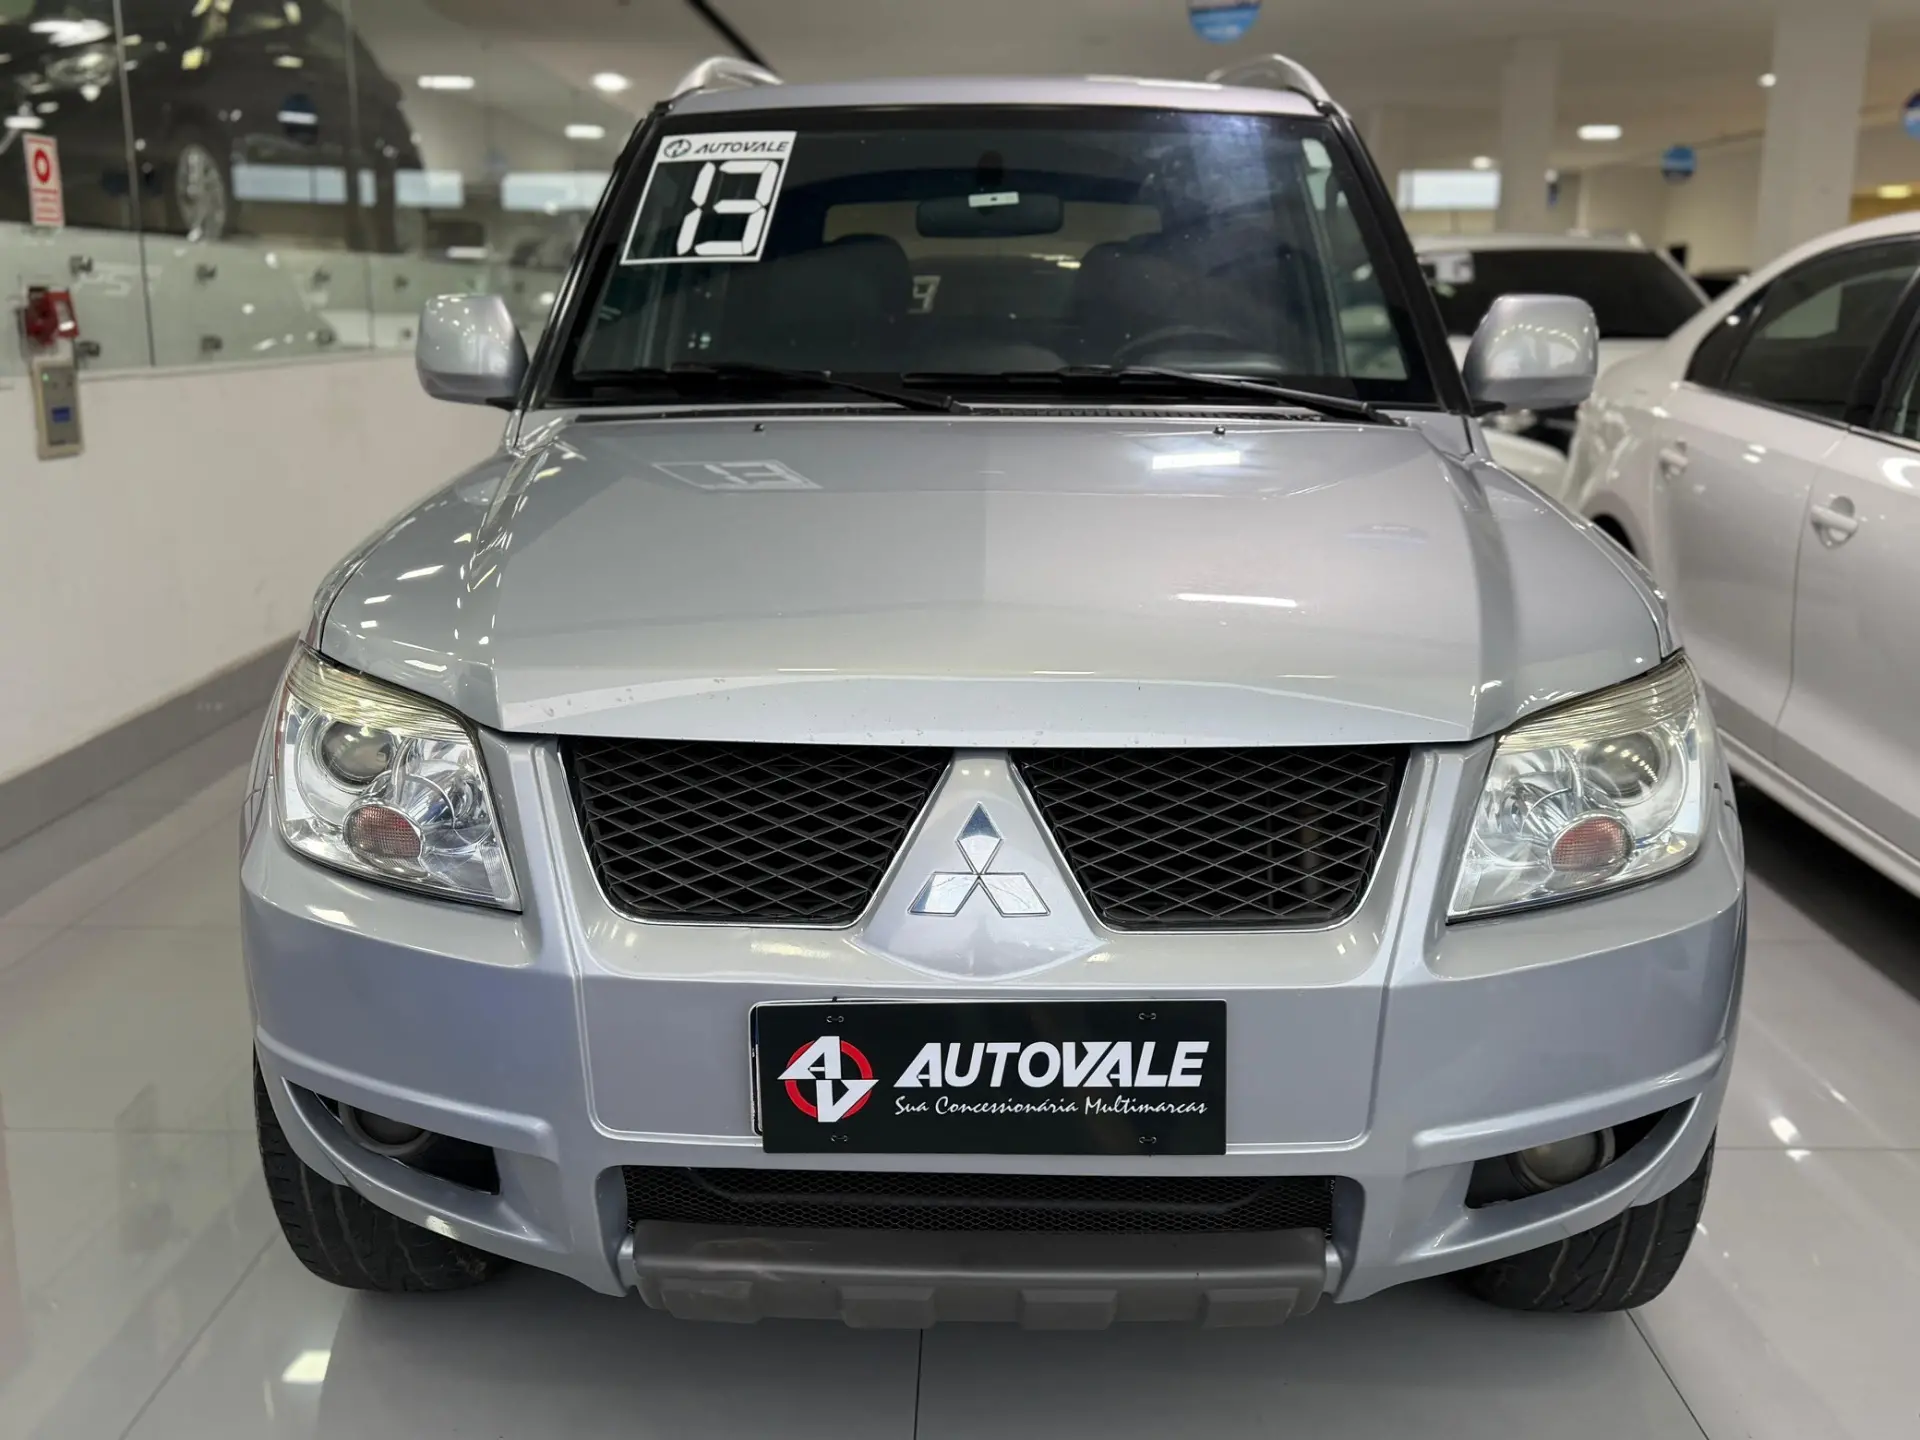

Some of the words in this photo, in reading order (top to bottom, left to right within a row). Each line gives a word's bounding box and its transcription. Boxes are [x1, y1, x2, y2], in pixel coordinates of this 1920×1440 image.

[694, 141, 789, 154] AUTOVALE
[676, 160, 780, 256] 13
[893, 1040, 1210, 1088] AUTOVALE
[894, 1095, 930, 1116] Sua
[935, 1096, 1080, 1115] Concessionária
[1084, 1095, 1208, 1115] Multimarcas
